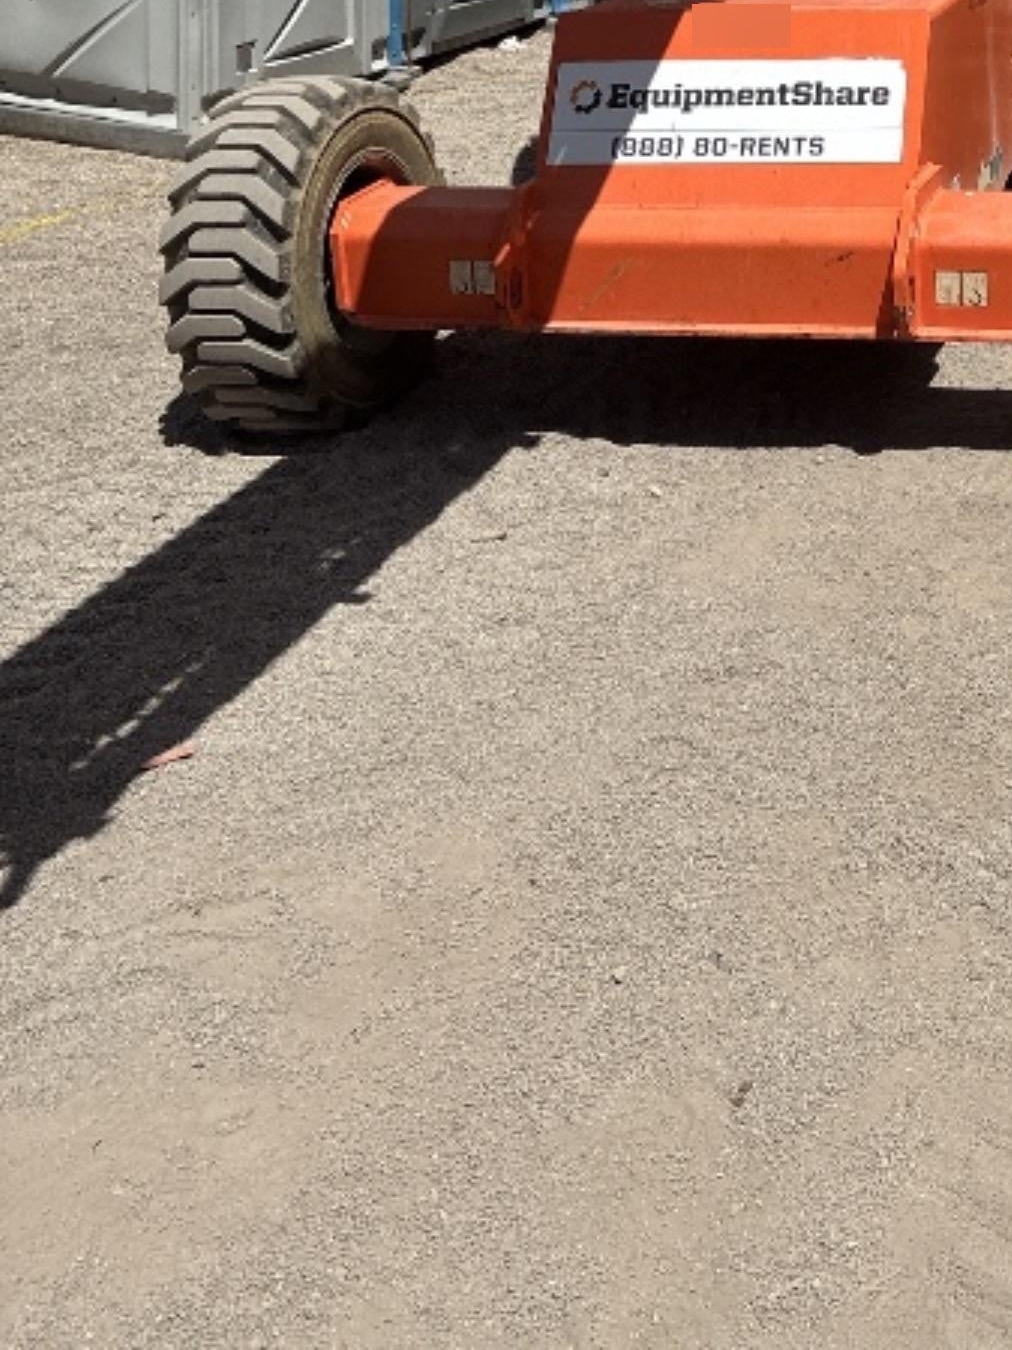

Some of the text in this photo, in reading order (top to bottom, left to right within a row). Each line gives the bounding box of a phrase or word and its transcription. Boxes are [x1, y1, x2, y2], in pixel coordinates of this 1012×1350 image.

[605, 80, 890, 114] EquipmentShare
[611, 136, 826, 158] (888) 80-RENTS
